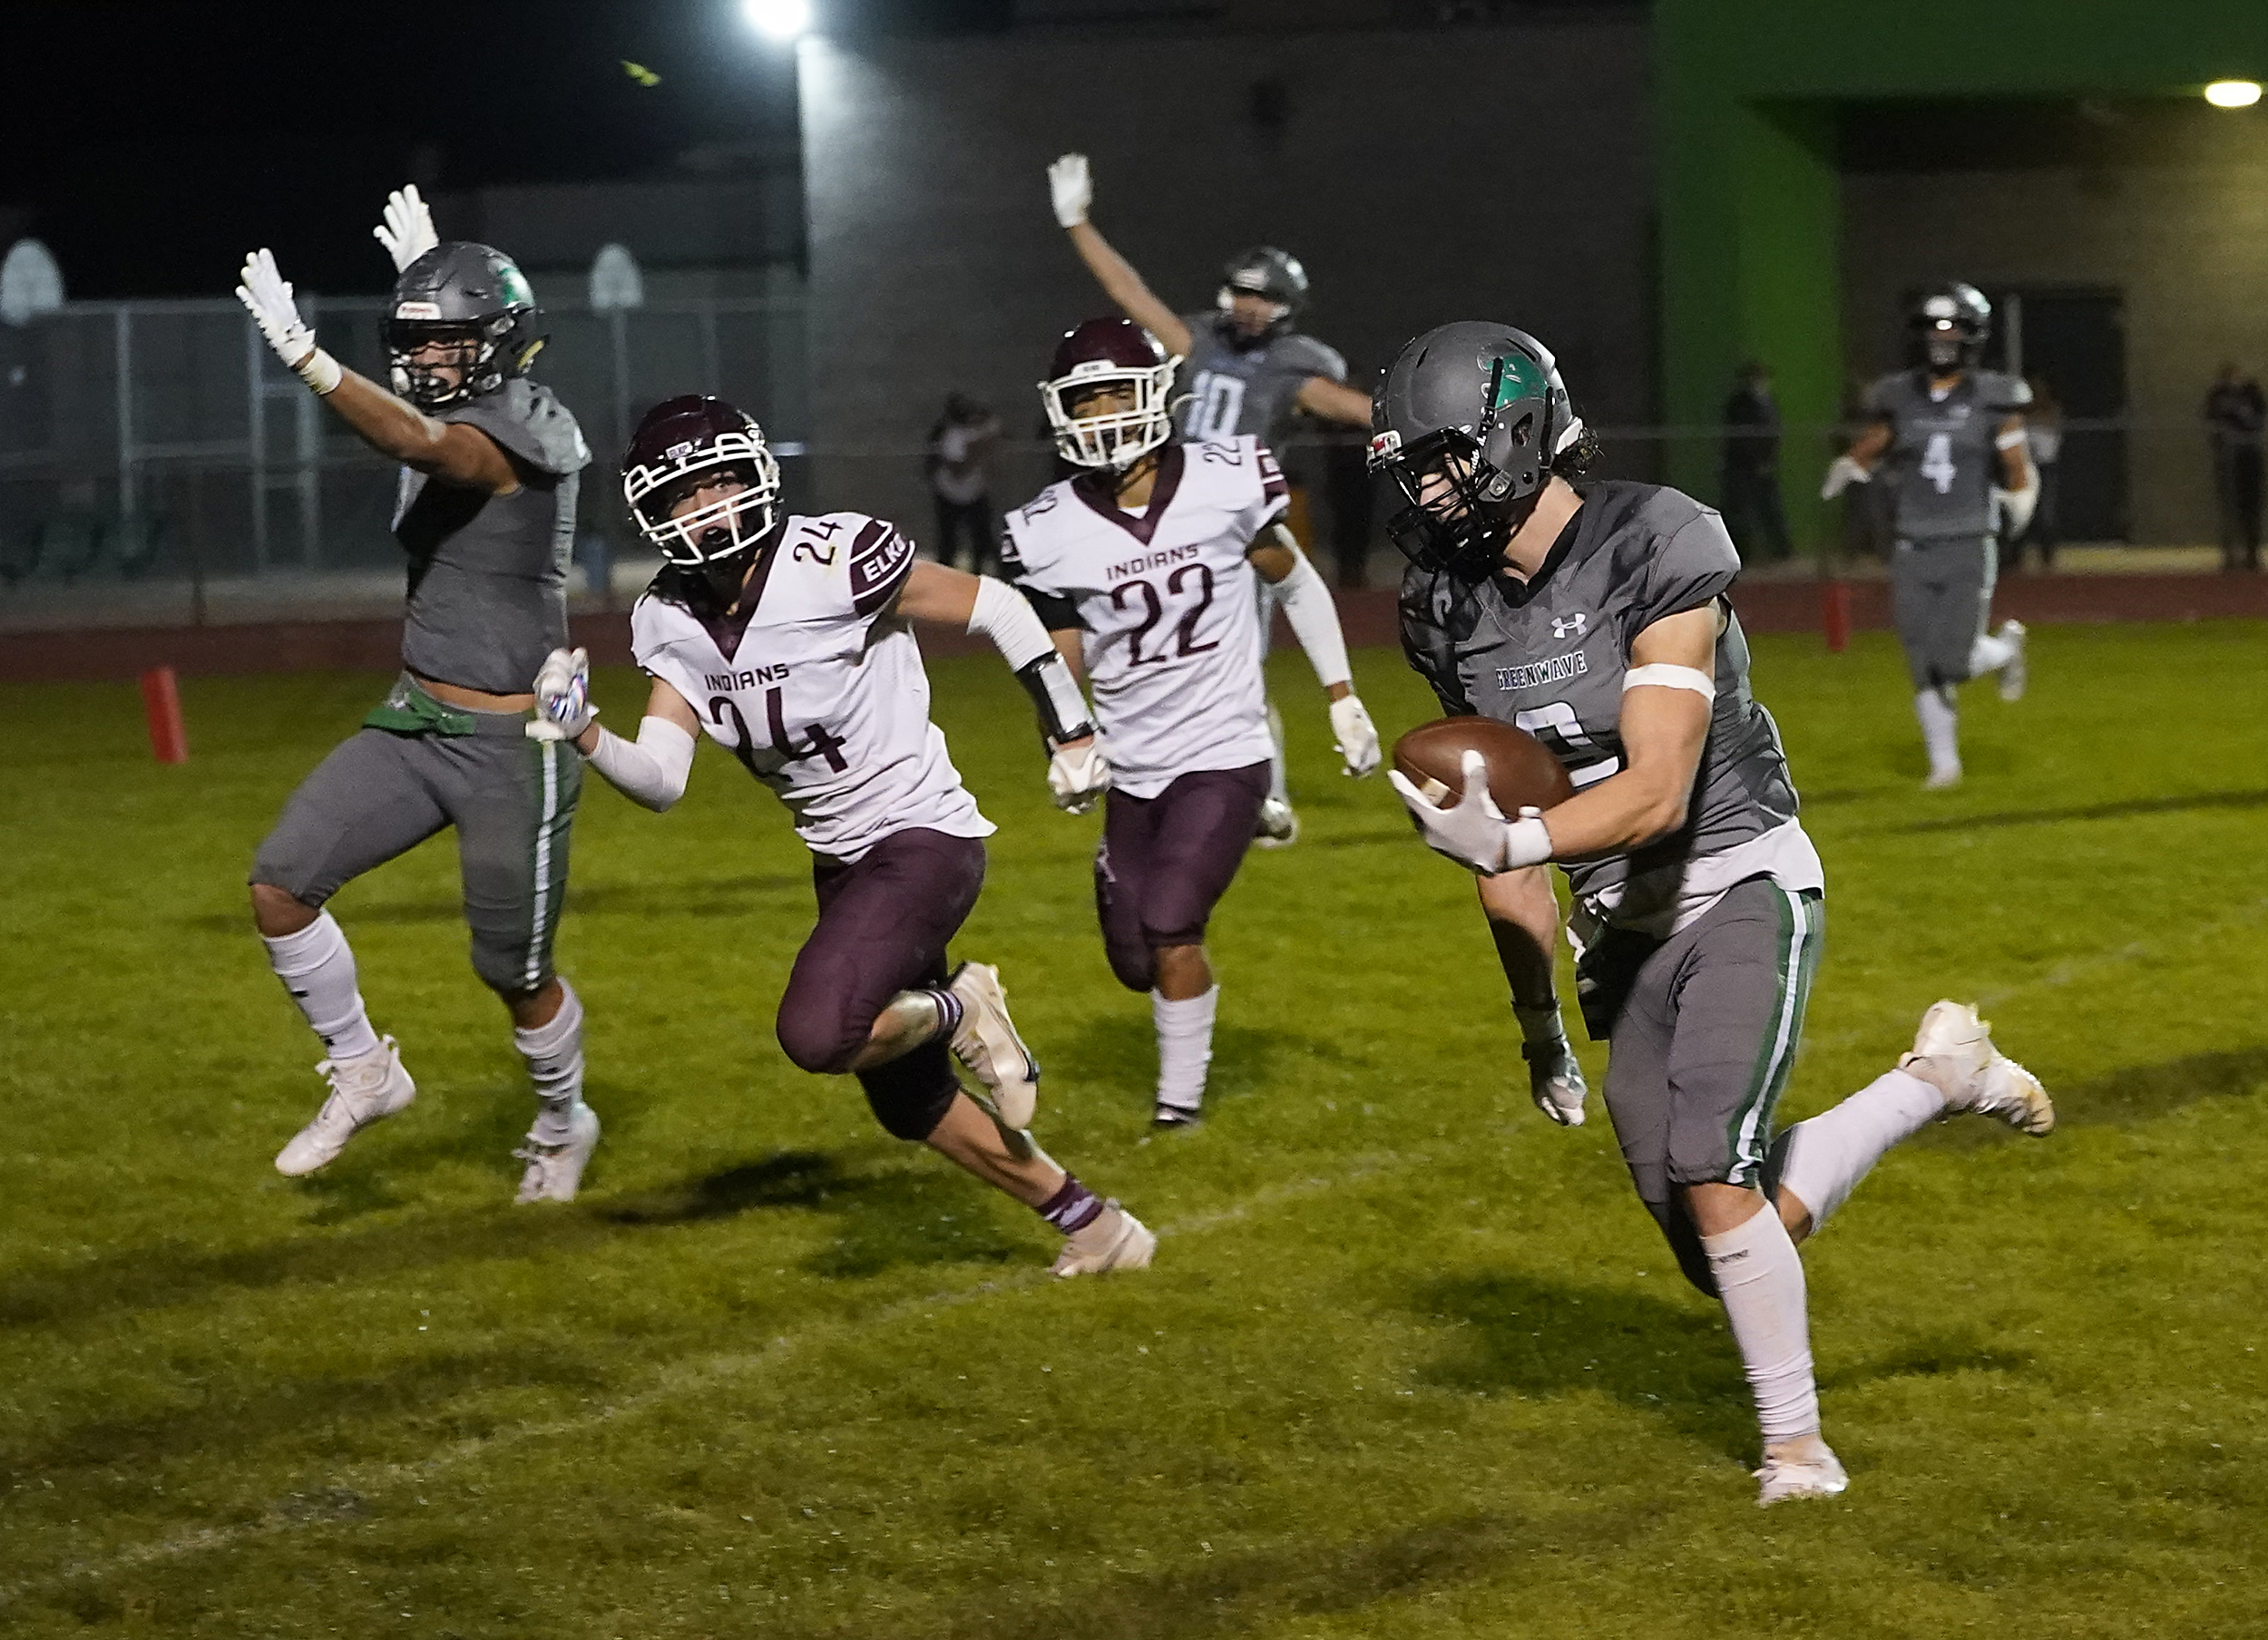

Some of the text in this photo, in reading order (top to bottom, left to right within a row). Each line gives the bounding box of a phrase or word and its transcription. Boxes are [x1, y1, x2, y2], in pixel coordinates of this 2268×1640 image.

[1920, 433, 1958, 494] 4
[793, 521, 844, 566] 24
[1106, 543, 1199, 581] INDIANS
[1110, 563, 1220, 668] 22
[704, 663, 790, 691] INDIANS
[1495, 649, 1589, 690] GREENWAVE
[708, 686, 848, 784] 24
